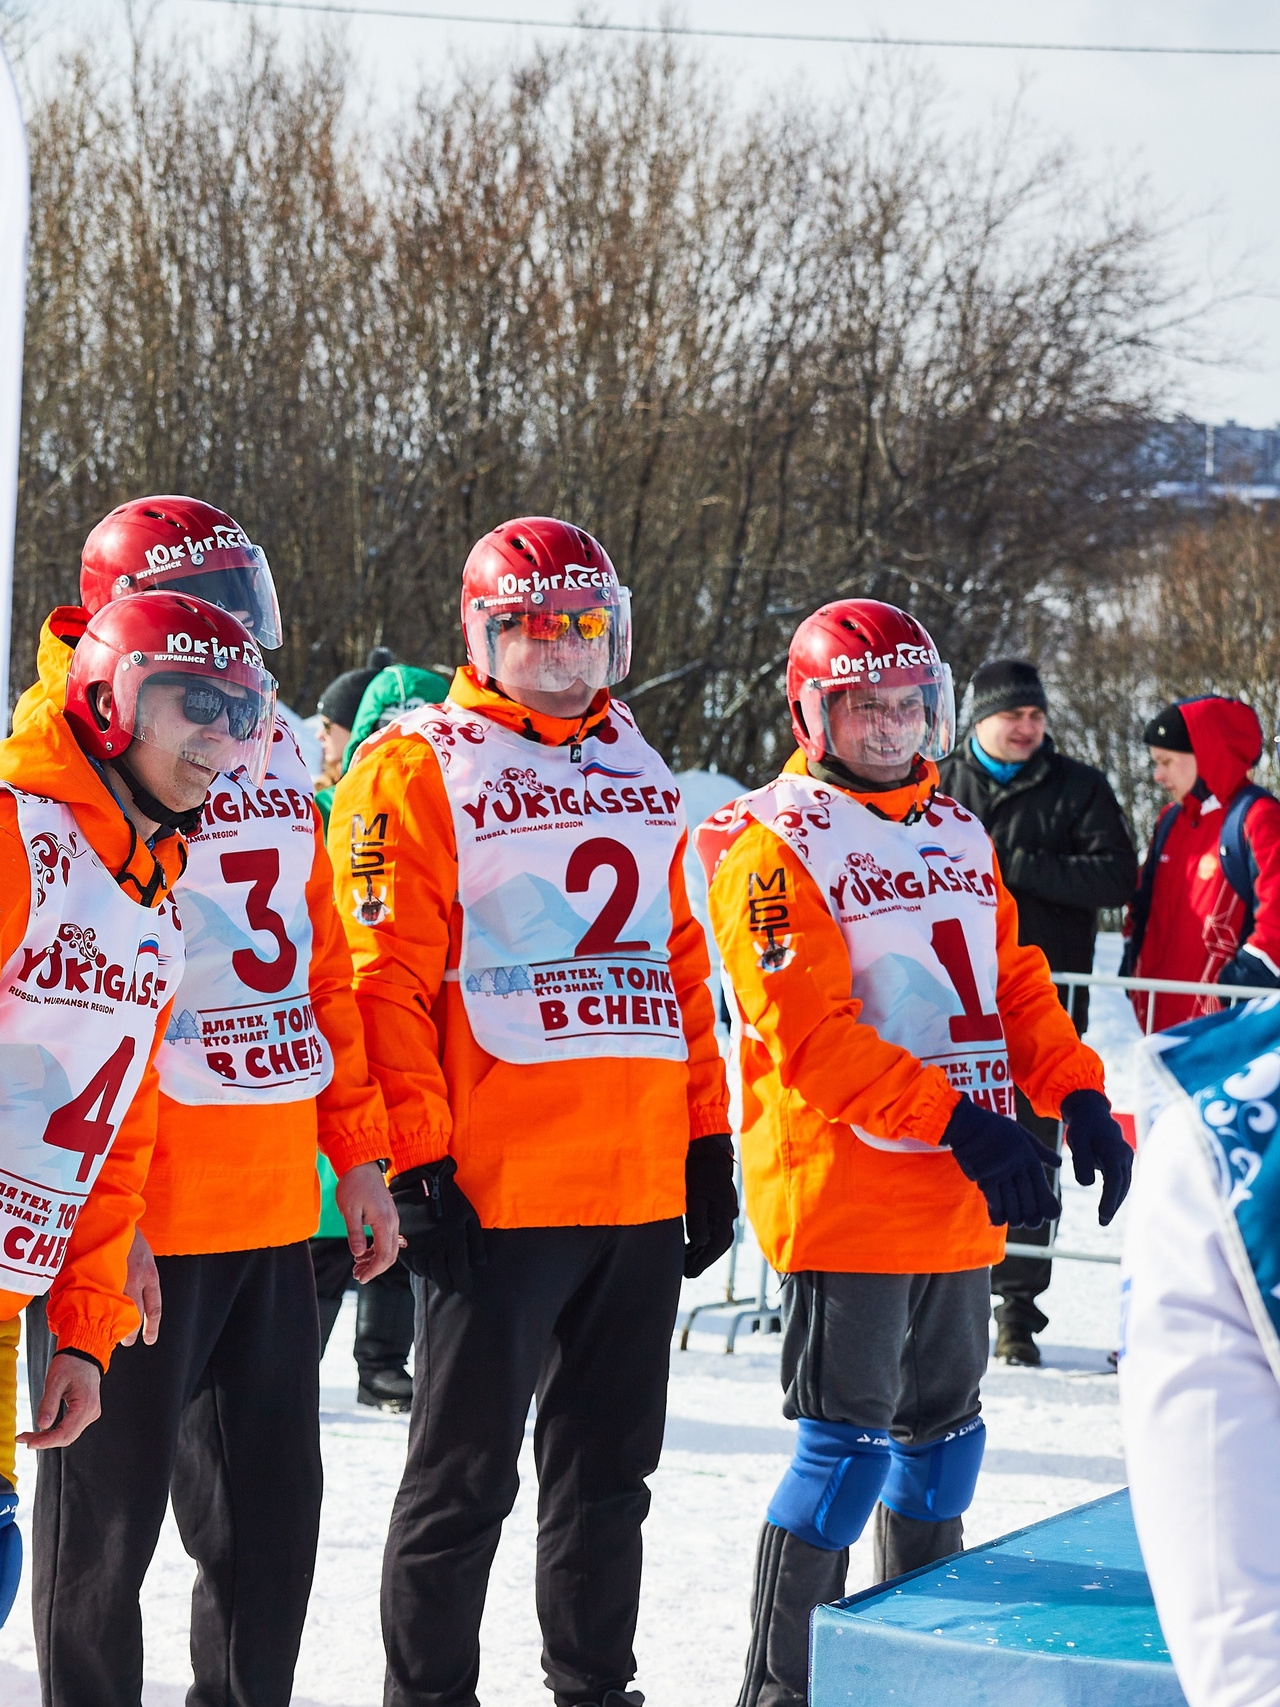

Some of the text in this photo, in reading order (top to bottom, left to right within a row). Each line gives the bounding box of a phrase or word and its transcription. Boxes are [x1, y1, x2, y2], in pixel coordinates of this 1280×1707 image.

[136, 560, 182, 580] МУРМАНСК
[154, 654, 206, 665] МУРМАНСК
[212, 830, 238, 840] REGION
[555, 820, 583, 830] REGION
[565, 837, 650, 957] 2
[220, 848, 297, 994] 3
[534, 970, 566, 985] ДЛЯ
[534, 981, 604, 997] КТО ЗНАЕТ
[607, 967, 674, 993] ТОЛК
[931, 918, 1003, 1043] 1
[8, 986, 115, 1015] RUSSIA, MURMANSK REGION
[539, 995, 679, 1031] В СНЕГЕ
[202, 1018, 235, 1035] ДЛЯ
[203, 1030, 268, 1047] КТО ЗНАЕТ
[206, 1052, 237, 1080] В
[42, 1034, 137, 1183] 4
[4, 1203, 49, 1227] ЗНАЕТ
